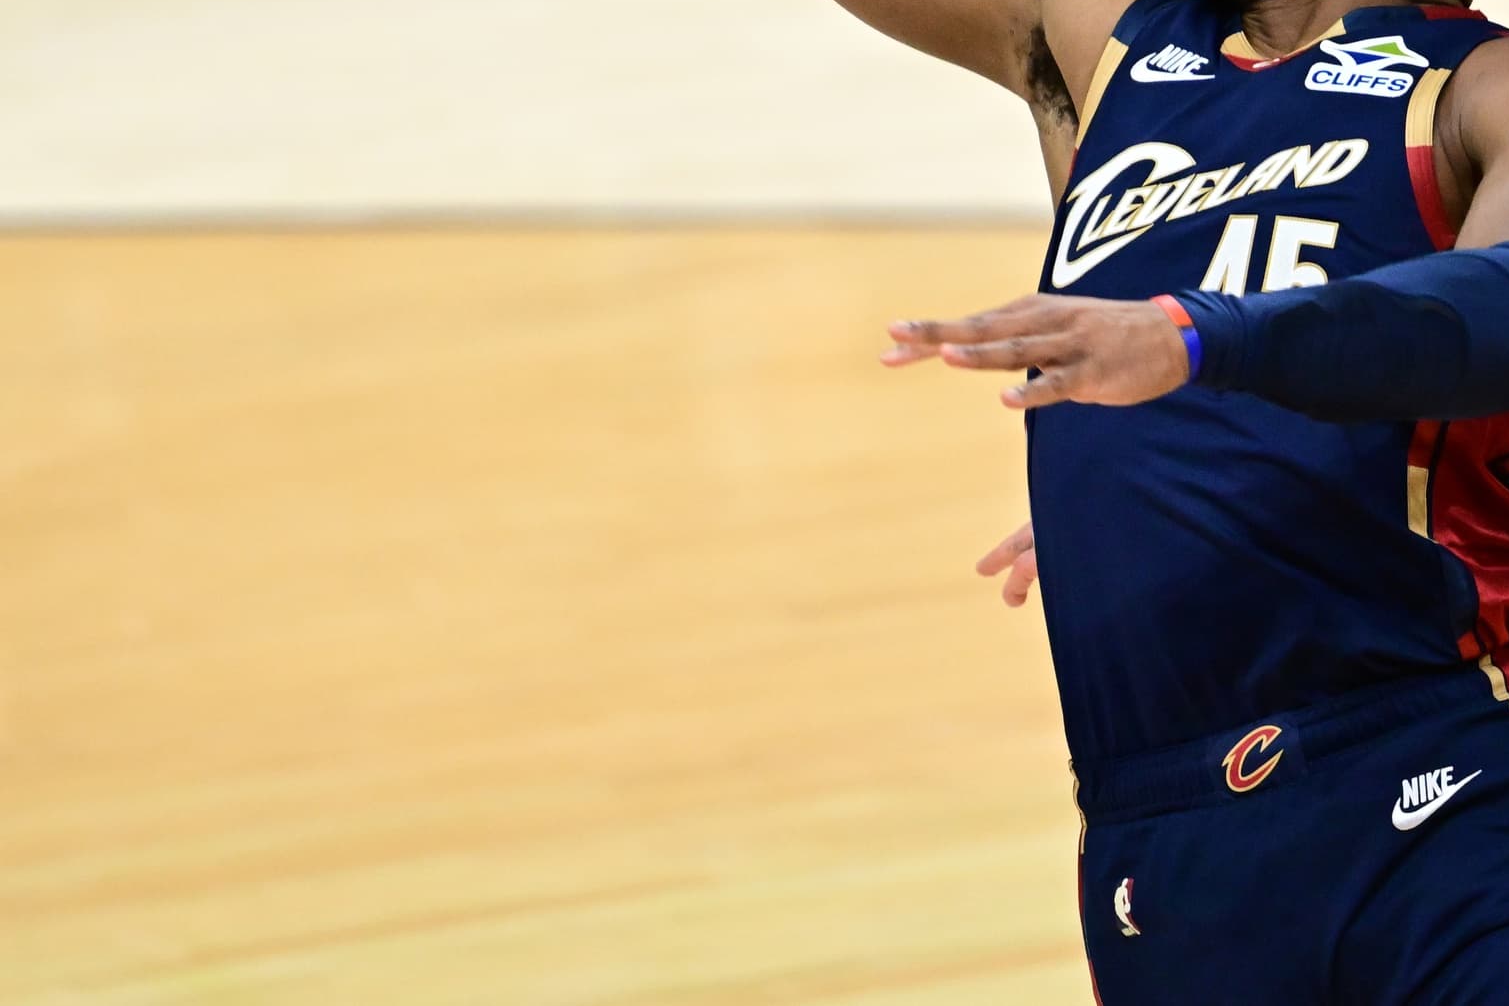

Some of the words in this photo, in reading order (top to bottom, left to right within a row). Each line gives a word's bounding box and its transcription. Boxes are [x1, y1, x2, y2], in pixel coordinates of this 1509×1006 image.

[1149, 43, 1210, 75] NIKE
[1311, 69, 1407, 92] CLIFFS
[1052, 139, 1369, 289] CLEVELAND
[1221, 724, 1285, 793] C
[1401, 765, 1456, 810] NIKE
